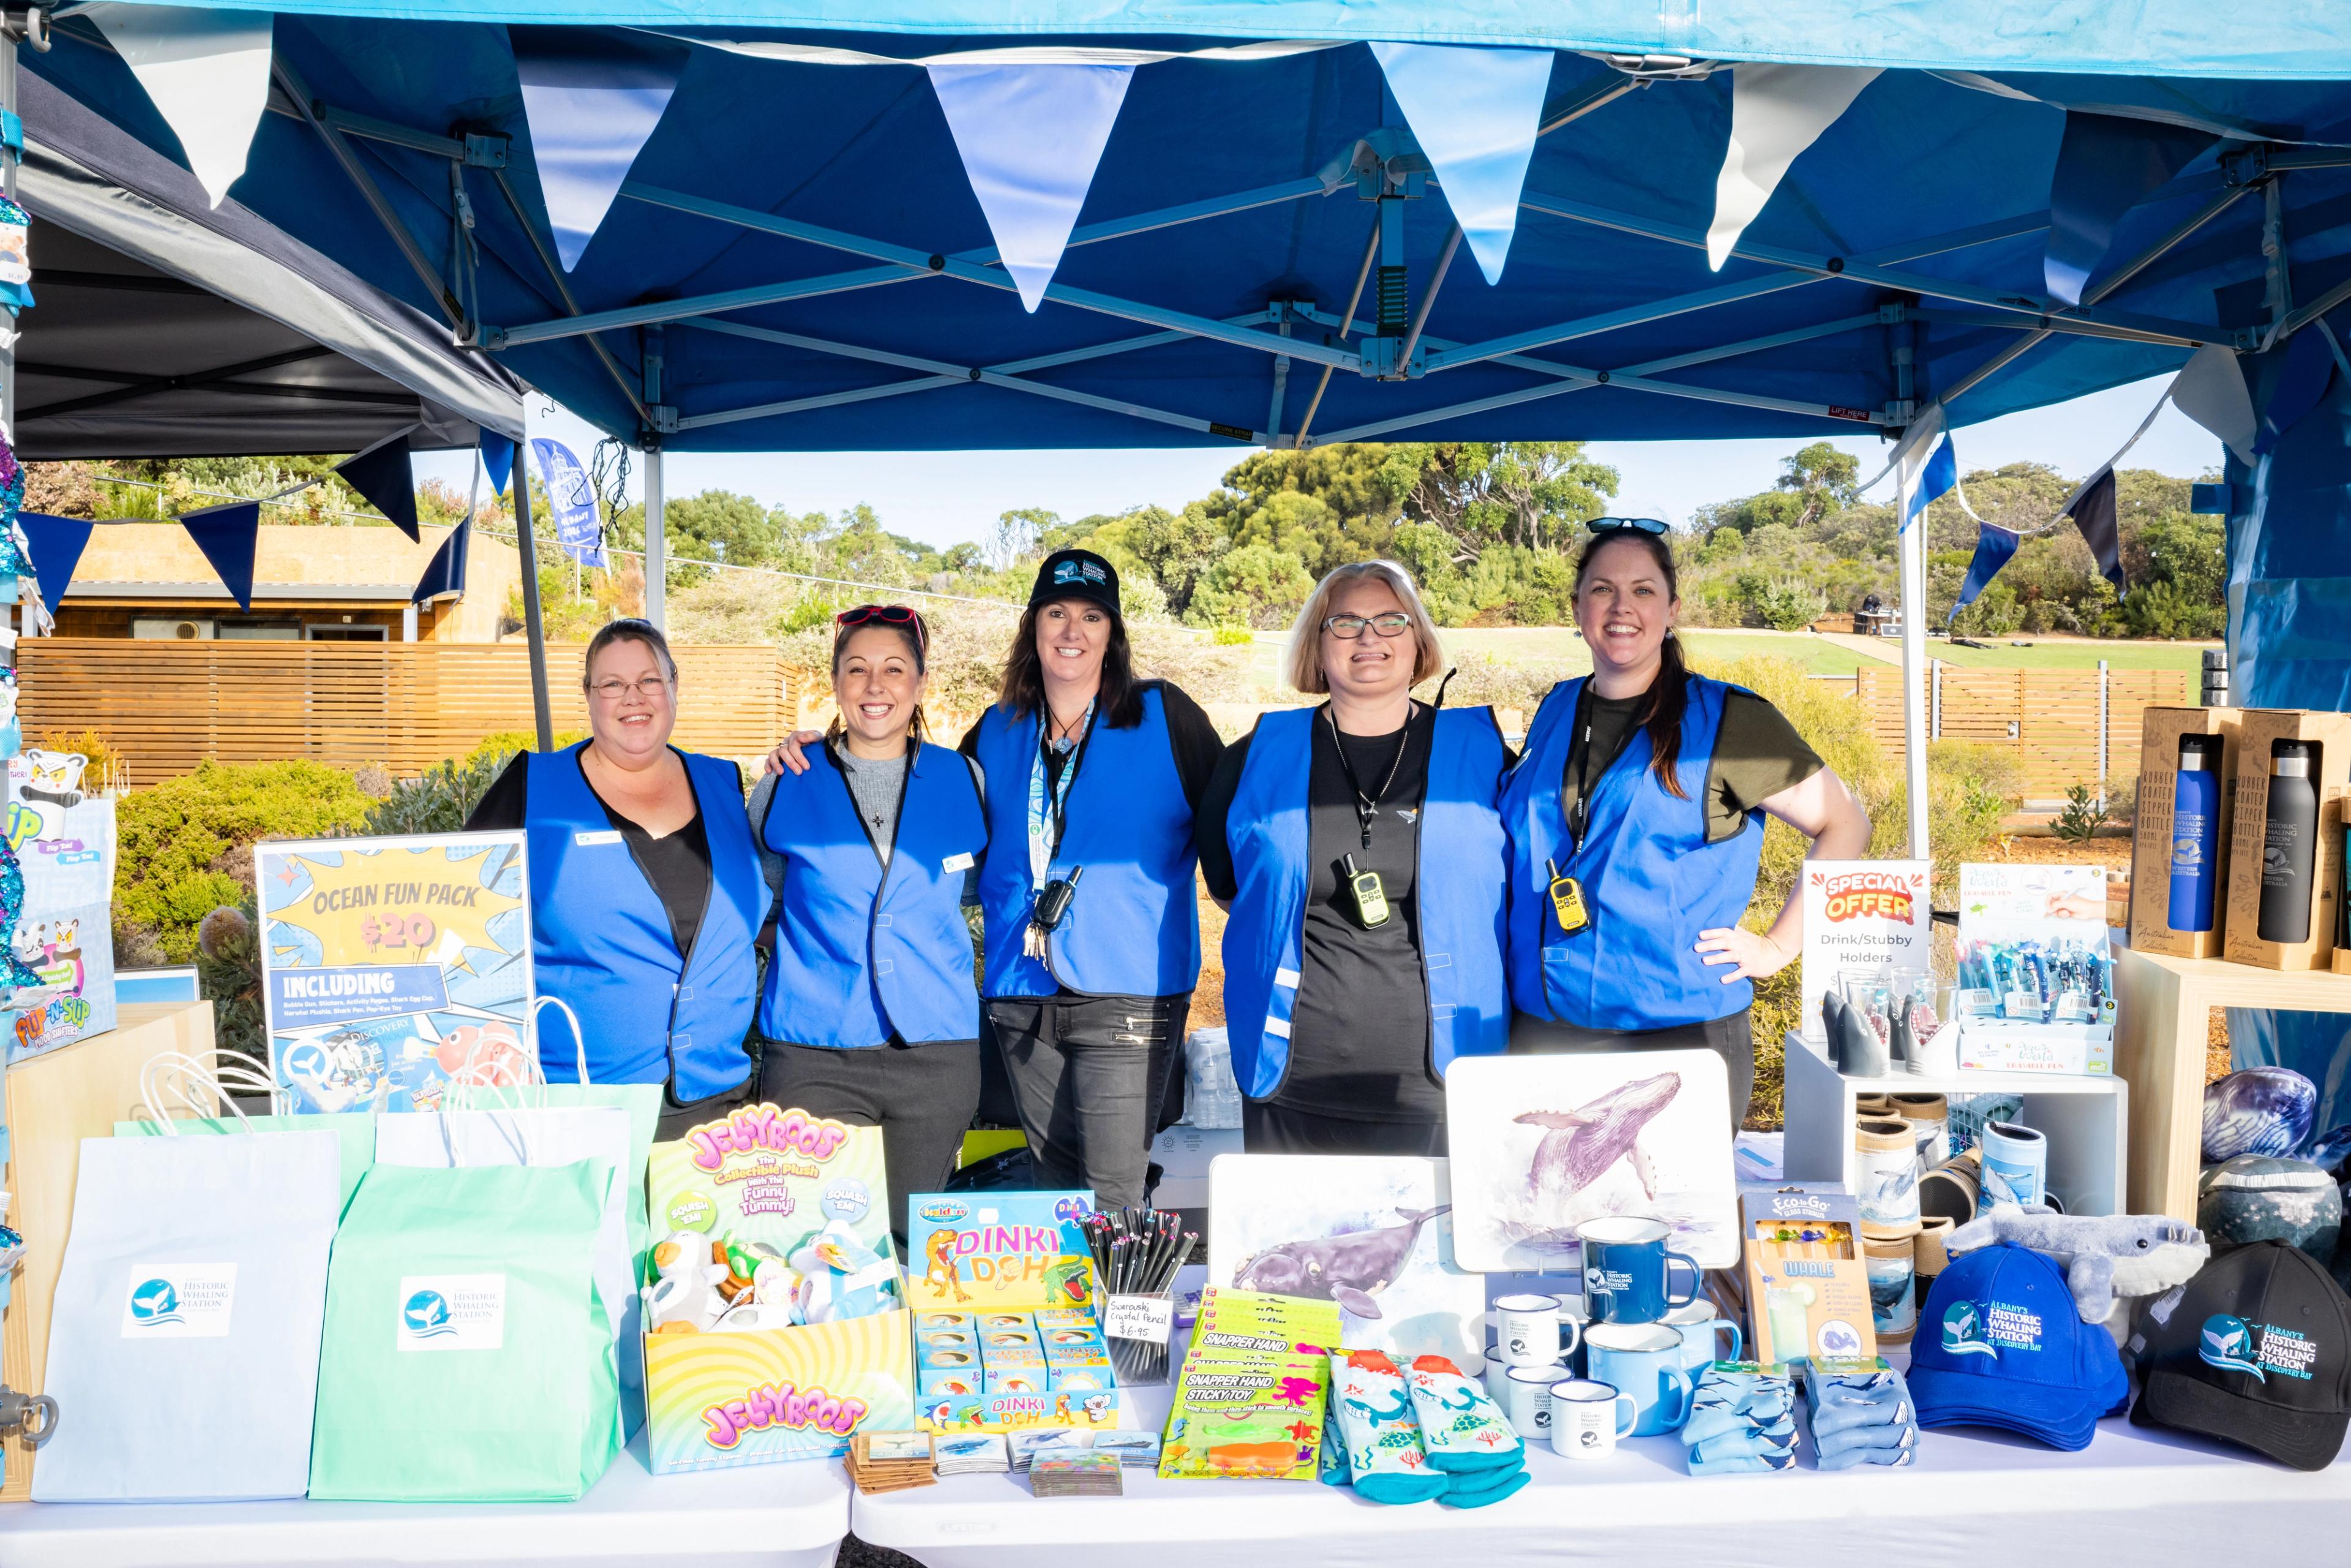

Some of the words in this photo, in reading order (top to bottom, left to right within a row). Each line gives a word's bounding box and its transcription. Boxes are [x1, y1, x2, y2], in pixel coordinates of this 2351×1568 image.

[1848, 409, 1867, 418] HERE
[561, 511, 588, 525] ALBANY
[563, 527, 580, 536] 2026
[1082, 571, 1103, 582] STATION
[2143, 770, 2173, 784] RUBBER
[2237, 775, 2265, 790] RUBBER
[2143, 786, 2172, 800] COATED
[2235, 791, 2264, 806] COATED
[2142, 801, 2171, 815] SIPPER
[2235, 806, 2263, 822] SIPPER
[2140, 816, 2170, 831] BOTTLE
[2233, 822, 2261, 838] BOTTLE
[2140, 831, 2157, 841] 500ML
[1827, 874, 1908, 895] SPECIAL
[313, 883, 378, 914] OCEAN
[383, 882, 422, 905] FUN
[426, 883, 482, 907] PACK
[1827, 893, 1910, 917] OFFER
[360, 912, 437, 953] $20
[2137, 927, 2174, 940] Australian
[1821, 934, 1912, 947] Drink/Stubby
[2140, 940, 2169, 951] Collection
[2229, 936, 2263, 950] Australian
[1840, 953, 1892, 962] Holders
[2232, 950, 2258, 962] Collection
[283, 972, 395, 998] INCLUDING
[34, 1032, 51, 1048] MOOD
[52, 1025, 79, 1039] SHIFTERS
[350, 1017, 410, 1042] DISCOVERY
[714, 1164, 780, 1185] Collectible
[782, 1163, 820, 1178] Plush
[748, 1177, 768, 1187] With
[768, 1176, 784, 1185] The
[743, 1187, 787, 1200] Funny
[826, 1190, 868, 1206] SQUASH
[670, 1201, 710, 1219] SQUISH
[740, 1198, 795, 1216] Tummy!
[1059, 1203, 1080, 1212] DINKI
[1784, 1208, 1801, 1218] GLASS
[1802, 1209, 1825, 1218] STRAWS
[955, 1225, 1060, 1255] DINKI
[1783, 1261, 1835, 1277] WHALE
[182, 1299, 222, 1308] STATION
[1991, 1300, 2028, 1314] ALBANY'S
[1143, 1313, 1167, 1325] Pencil
[1989, 1308, 2041, 1326] HISTORIC
[1987, 1318, 2042, 1335] WHALING
[2265, 1324, 2304, 1340] ALBANY'S
[1204, 1333, 1256, 1349] SNAPPER
[1254, 1338, 1288, 1352] HAND
[1987, 1327, 2033, 1343] STATION
[2262, 1331, 2317, 1353] HISTORIC
[1997, 1338, 2029, 1350] DISCOVERY
[2030, 1343, 2042, 1351] BAY
[2260, 1341, 2316, 1363] WHALING
[2258, 1351, 2306, 1371] STATION
[2265, 1362, 2300, 1378] DISCOVERY
[2300, 1370, 2313, 1380] BAY
[1185, 1375, 1240, 1387] SNAPPER
[1239, 1376, 1275, 1388] HAND
[1185, 1389, 1226, 1401] STICKY
[1224, 1389, 1254, 1401] TOY
[992, 1398, 1046, 1413] DINKI
[1183, 1403, 1201, 1412] Swing
[1286, 1405, 1313, 1416] surfaces!
